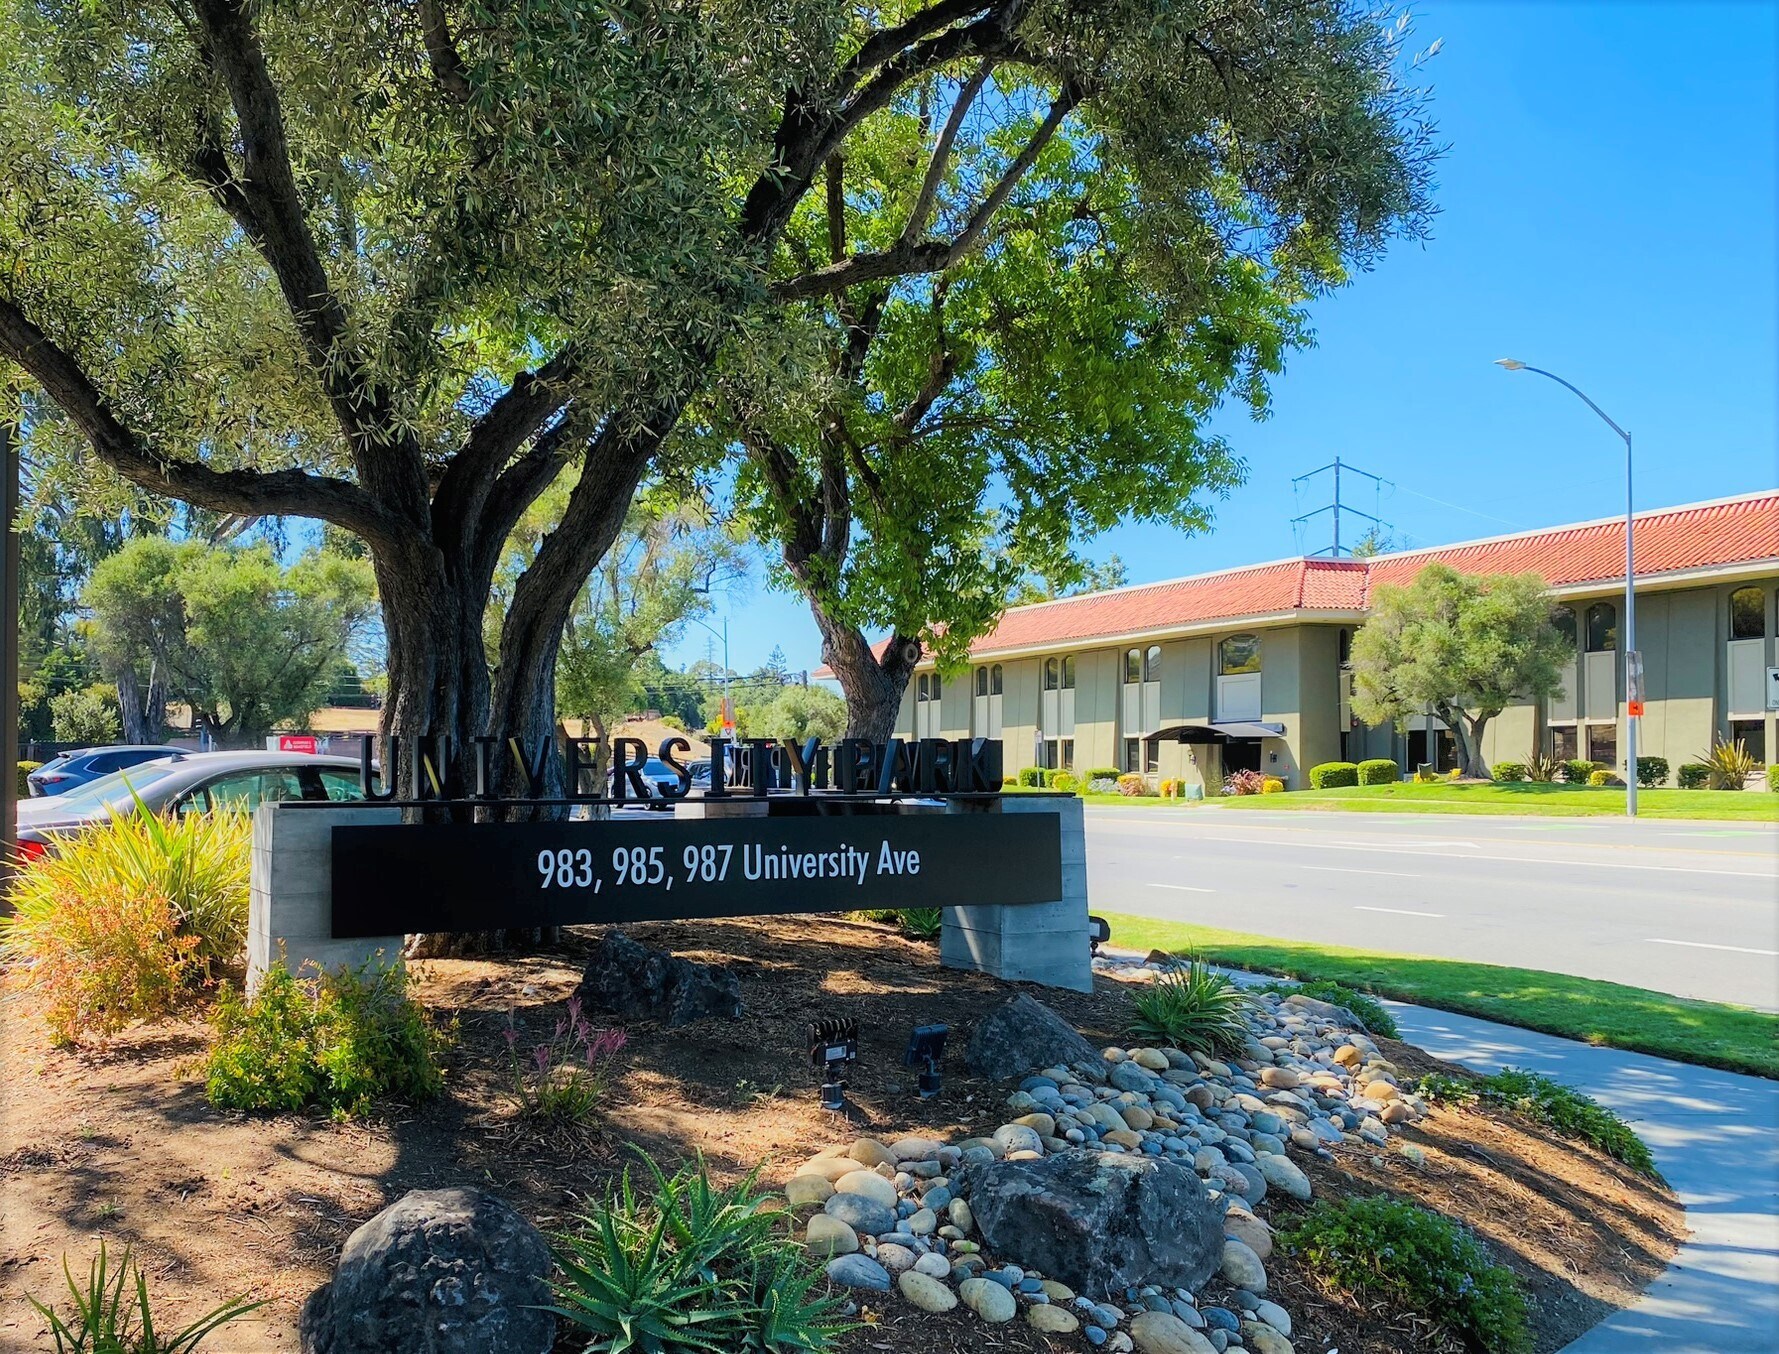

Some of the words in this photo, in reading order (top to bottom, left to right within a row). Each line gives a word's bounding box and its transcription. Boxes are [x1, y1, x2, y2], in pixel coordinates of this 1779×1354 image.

[360, 735, 823, 800] UNIVERSITY
[842, 737, 994, 796] PARK
[537, 848, 602, 894] 983,
[612, 846, 674, 891] 985,
[683, 844, 734, 883] 987
[743, 843, 870, 885] University
[876, 840, 920, 875] Ave
